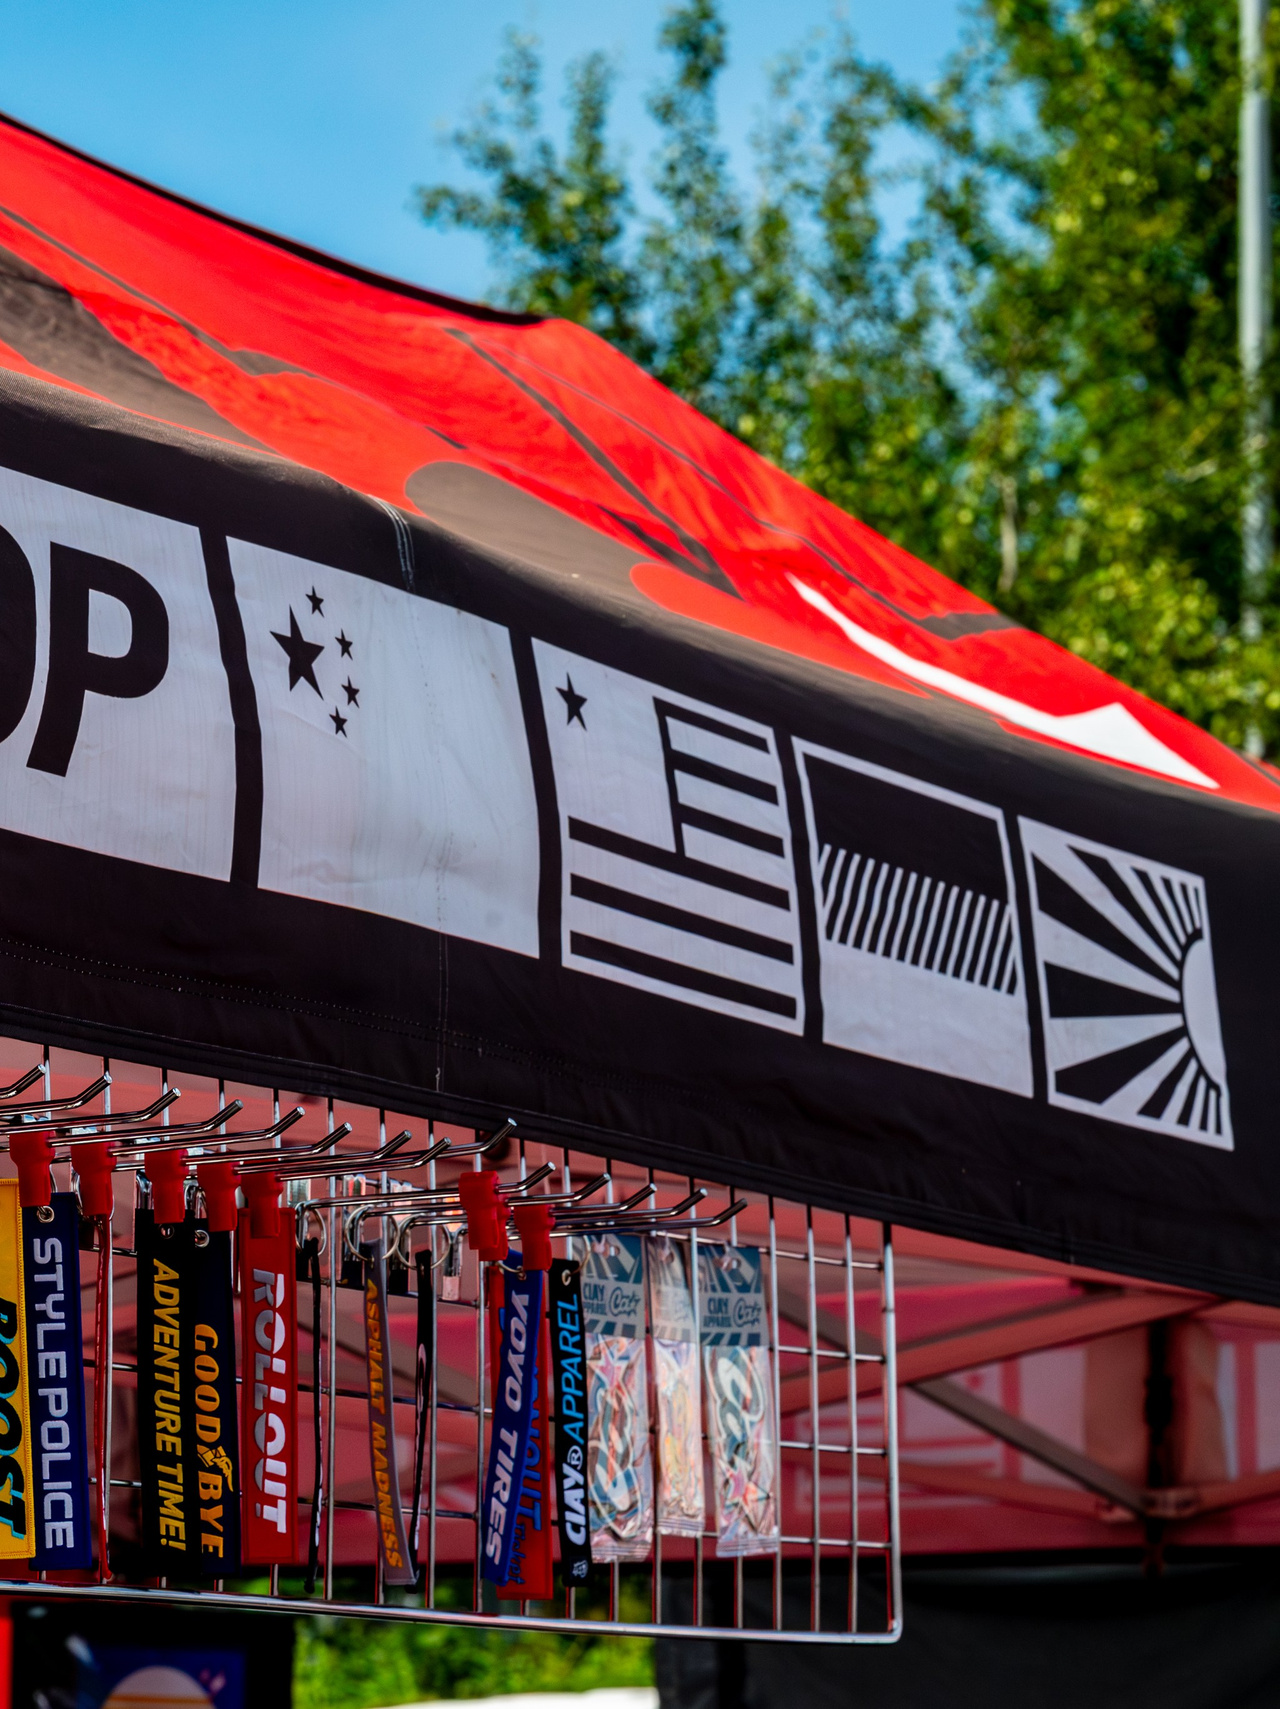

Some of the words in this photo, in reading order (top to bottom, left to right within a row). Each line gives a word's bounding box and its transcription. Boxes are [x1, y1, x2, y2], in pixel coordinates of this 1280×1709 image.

[152, 1258, 183, 1456] ADVENTURE
[194, 1323, 221, 1443] GOOD
[252, 1268, 287, 1534] ROLLOUT
[365, 1278, 387, 1415] ASPHALT
[505, 1289, 530, 1413] YOYO
[156, 1462, 187, 1551] TIME!
[198, 1470, 224, 1558] BYE
[371, 1421, 404, 1569] MADNESS
[485, 1427, 518, 1566] TIRES
